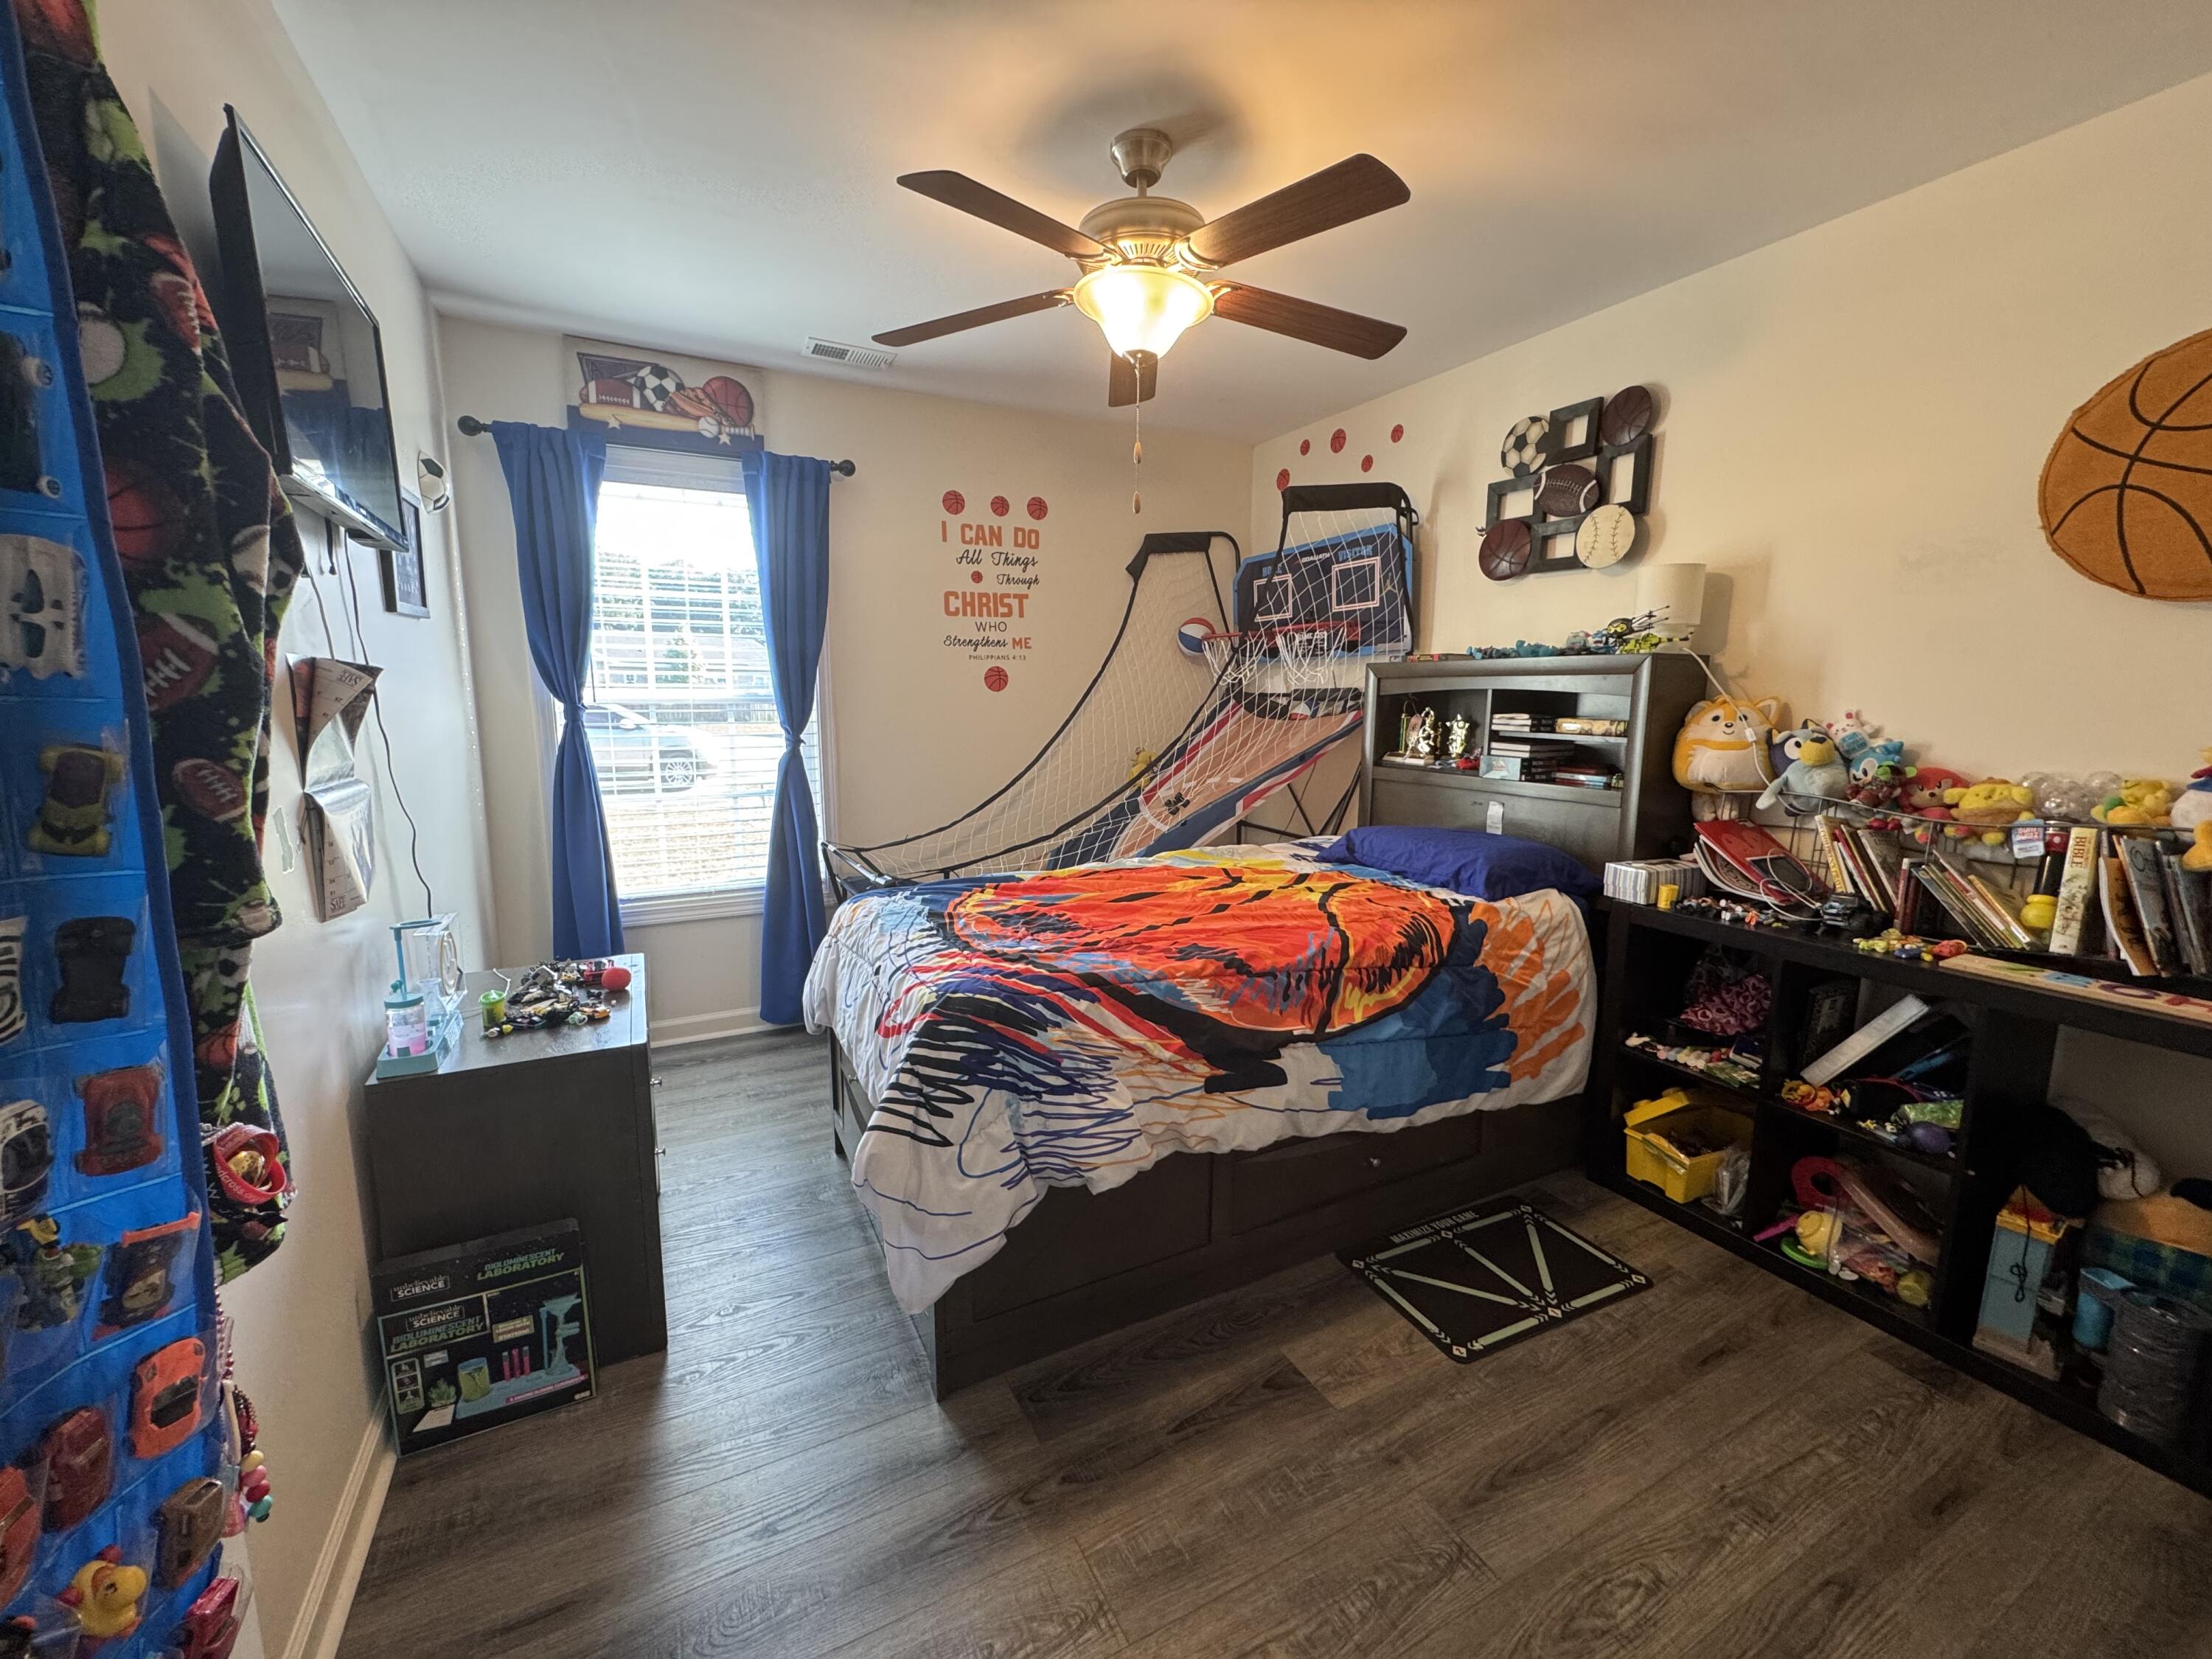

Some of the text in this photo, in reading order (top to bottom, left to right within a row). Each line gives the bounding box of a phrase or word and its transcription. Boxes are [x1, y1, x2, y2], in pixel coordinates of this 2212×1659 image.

[942, 521, 1040, 550] I CAN DO
[956, 549, 1039, 574] All Things
[1262, 563, 1284, 577] HOE
[996, 573, 1040, 590] Through
[944, 591, 1029, 619] CHRIST
[975, 621, 1008, 633] WHO
[943, 635, 1032, 653] Strengthens ME
[2070, 835, 2088, 869] BIBLE
[1390, 1224, 1435, 1244] MAXIMIZE
[1430, 1217, 1456, 1230] YOUR
[1452, 1210, 1477, 1222] GAME
[477, 1252, 565, 1281] LABORATORY
[397, 1280, 446, 1298] SCIENCE
[392, 1315, 481, 1343] BIOLUMINESCENT
[412, 1310, 460, 1328] SCIENCE
[390, 1321, 485, 1353] LABORATORY
